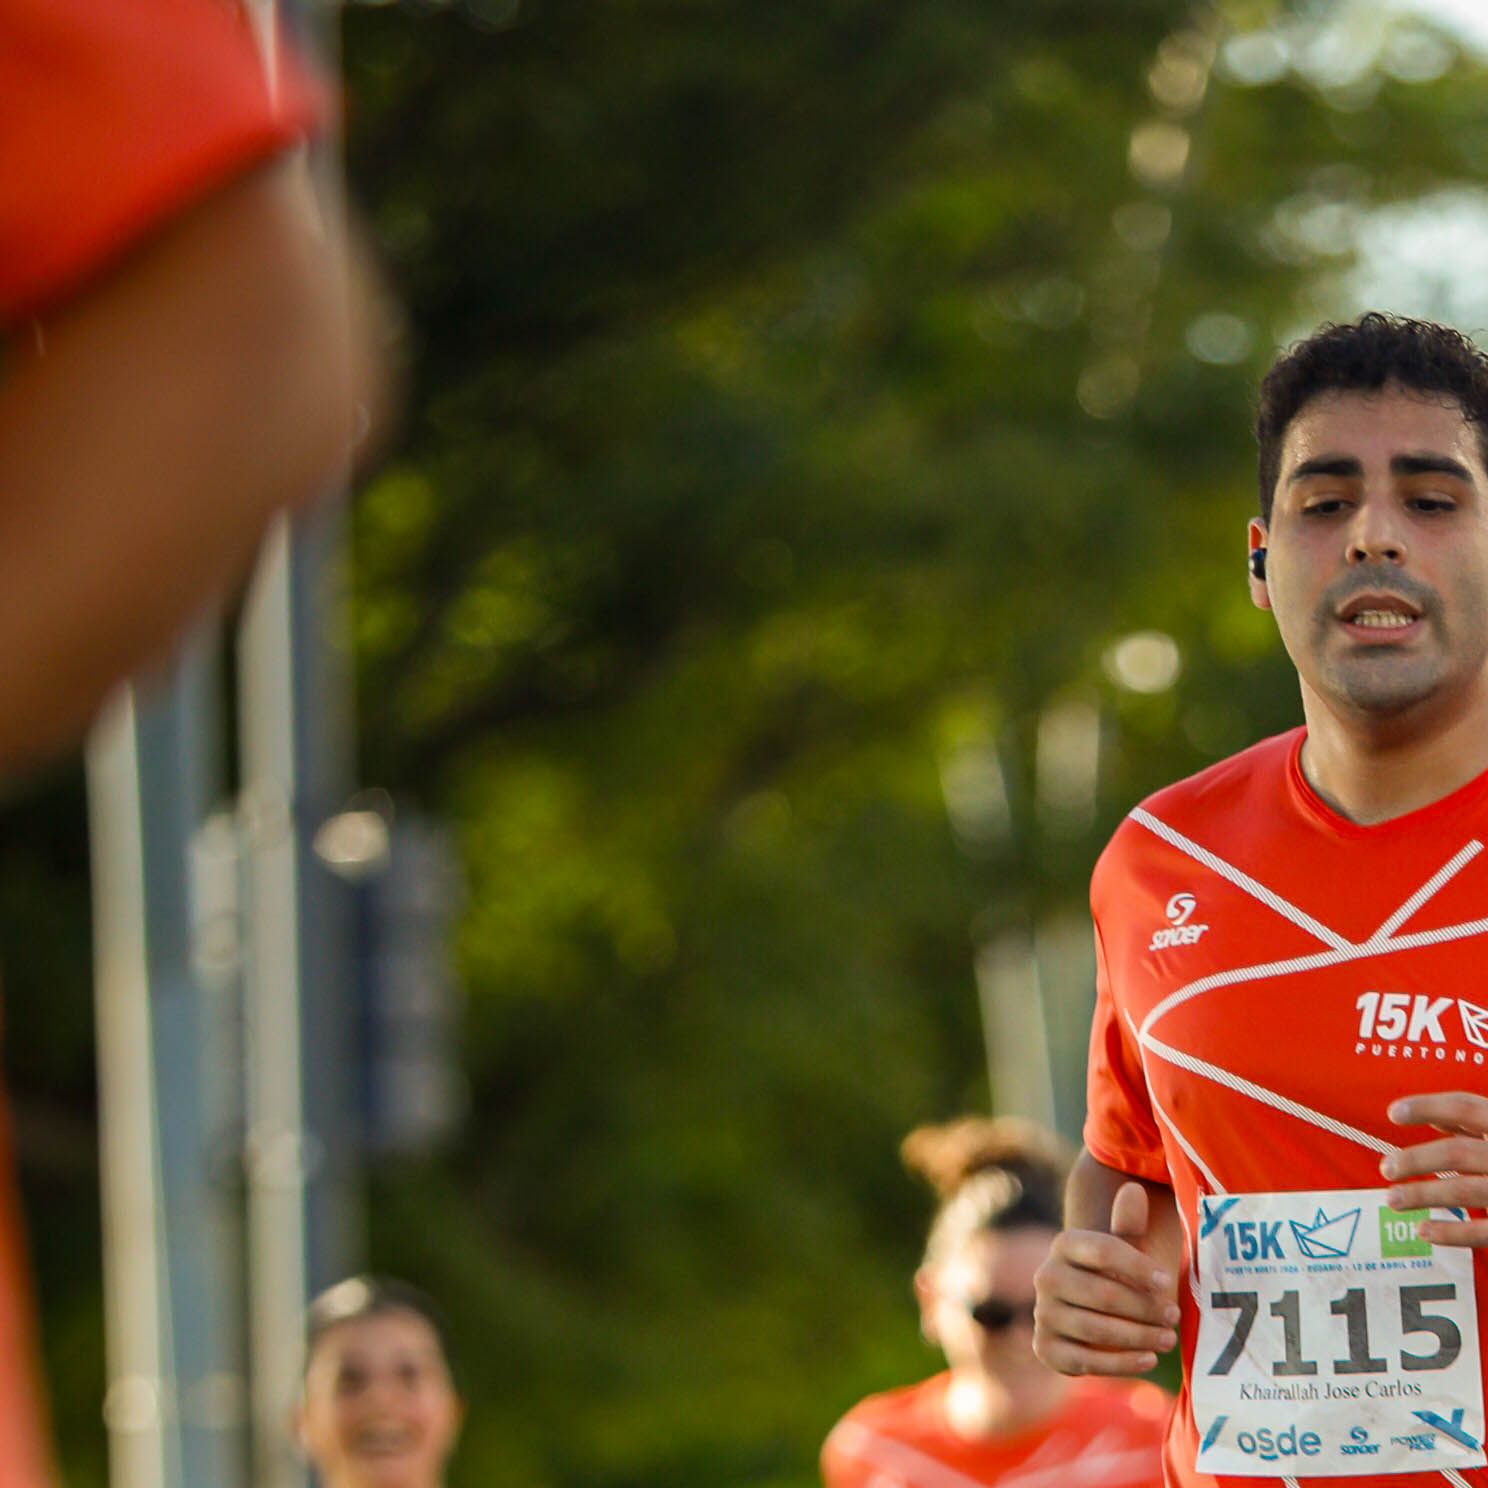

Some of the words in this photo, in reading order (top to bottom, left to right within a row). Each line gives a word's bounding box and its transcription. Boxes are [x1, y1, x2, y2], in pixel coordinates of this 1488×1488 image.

[1355, 991, 1454, 1043] 15K
[1355, 1042, 1446, 1060] PUERTO
[1223, 1220, 1287, 1261] 15K
[1207, 1282, 1463, 1377] 7115
[1324, 1380, 1361, 1400] Jose
[1365, 1379, 1423, 1398] Carlos
[1237, 1424, 1322, 1460] osde
